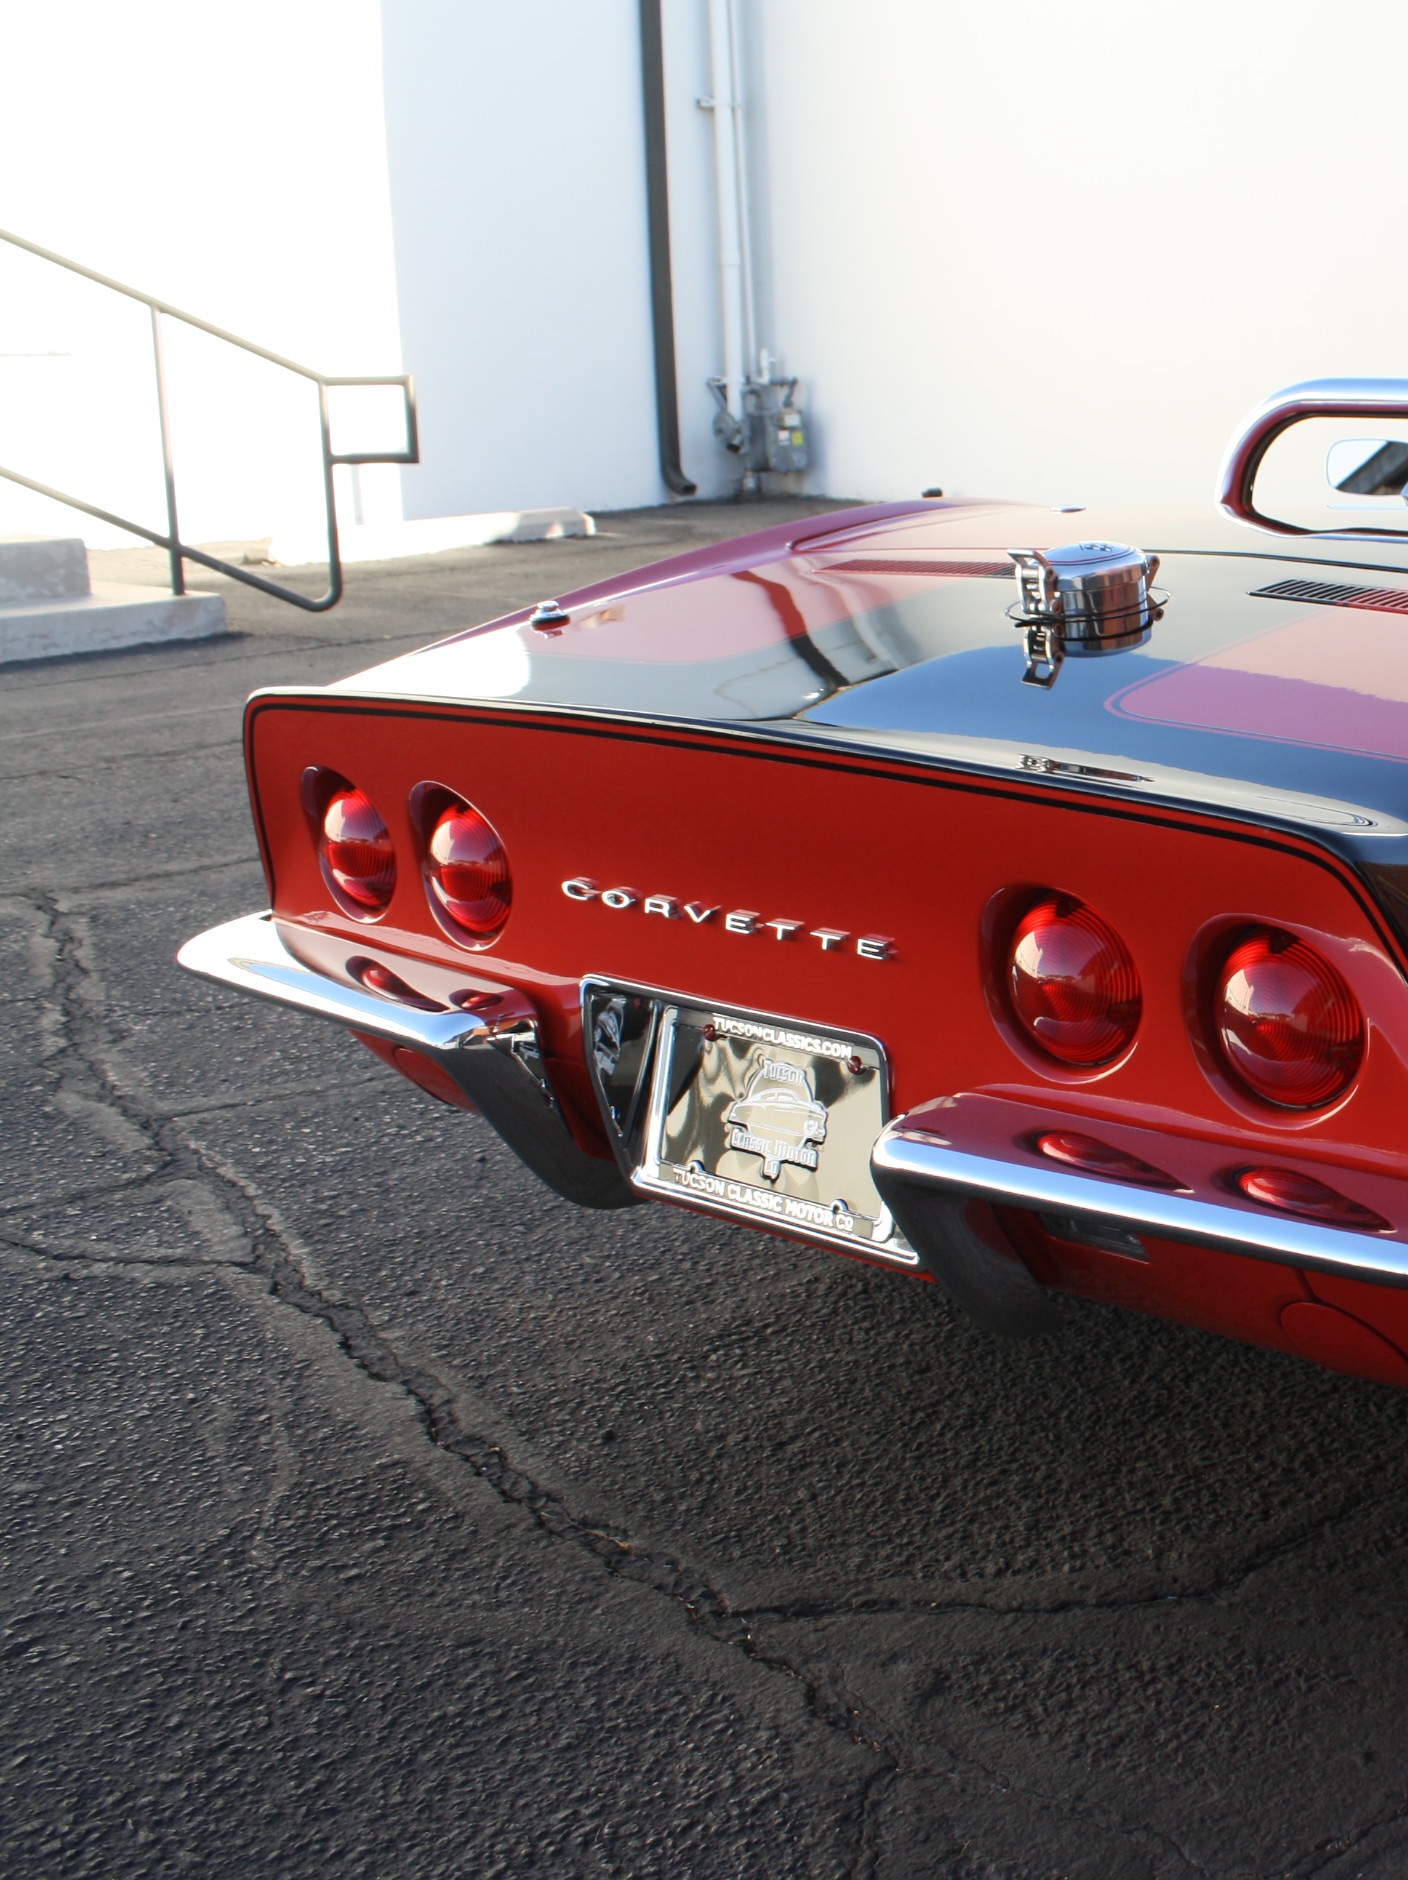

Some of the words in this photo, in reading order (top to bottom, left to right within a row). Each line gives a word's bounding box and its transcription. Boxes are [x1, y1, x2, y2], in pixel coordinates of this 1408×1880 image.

[561, 877, 897, 960] CORVETTE
[672, 1167, 725, 1197] TUCSON
[727, 1184, 784, 1214] CLASSIC
[785, 1199, 833, 1226] MOTOR
